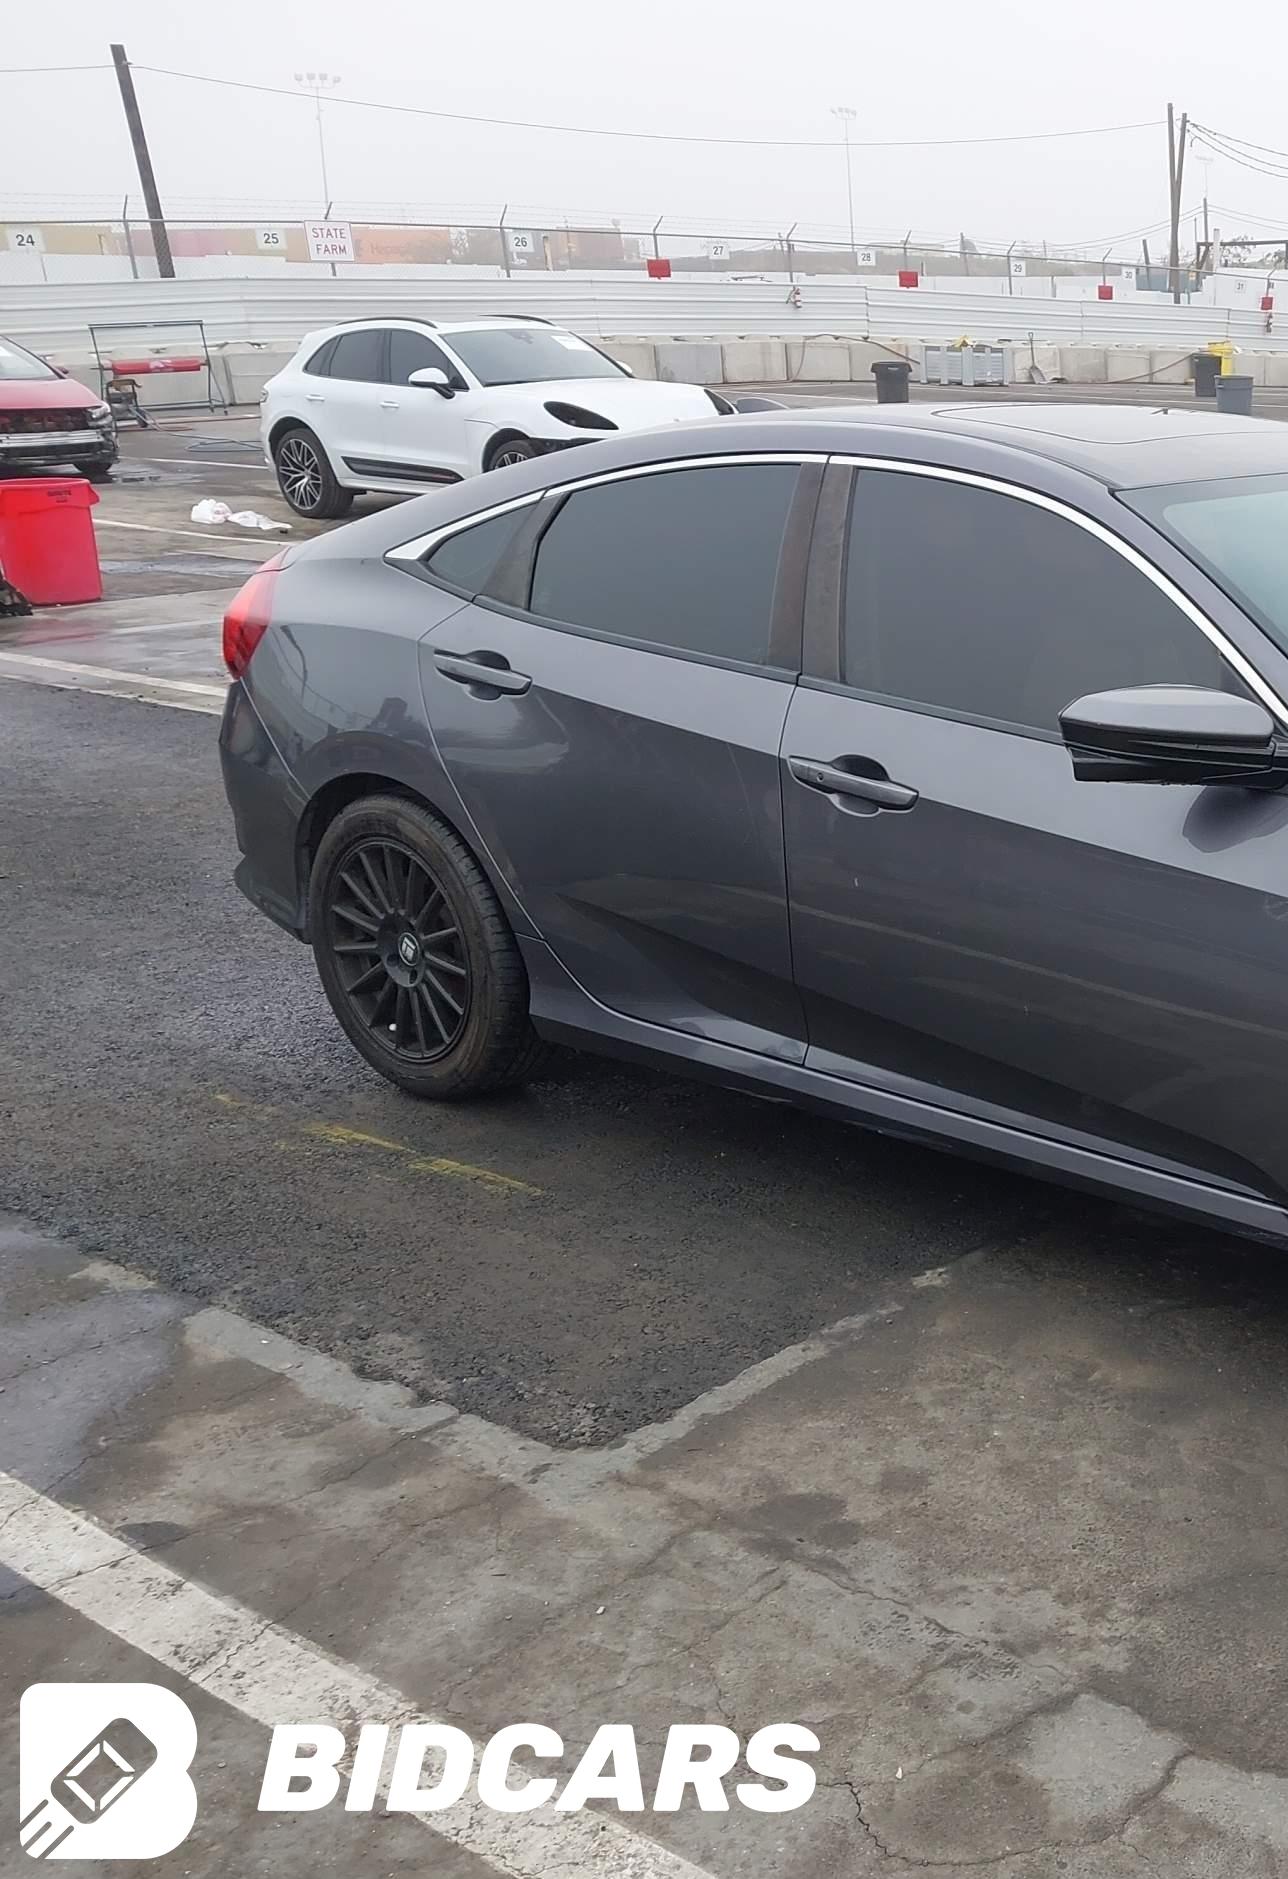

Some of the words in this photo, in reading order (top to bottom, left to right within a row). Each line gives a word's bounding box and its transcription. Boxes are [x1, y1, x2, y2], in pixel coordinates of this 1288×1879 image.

[262, 232, 280, 245] 25
[311, 227, 347, 240] STATE
[15, 233, 36, 247] 24
[513, 236, 528, 248] 26
[315, 243, 348, 256] FARM
[712, 245, 724, 256] 27
[860, 252, 871, 263] 28
[1013, 263, 1023, 274] 29
